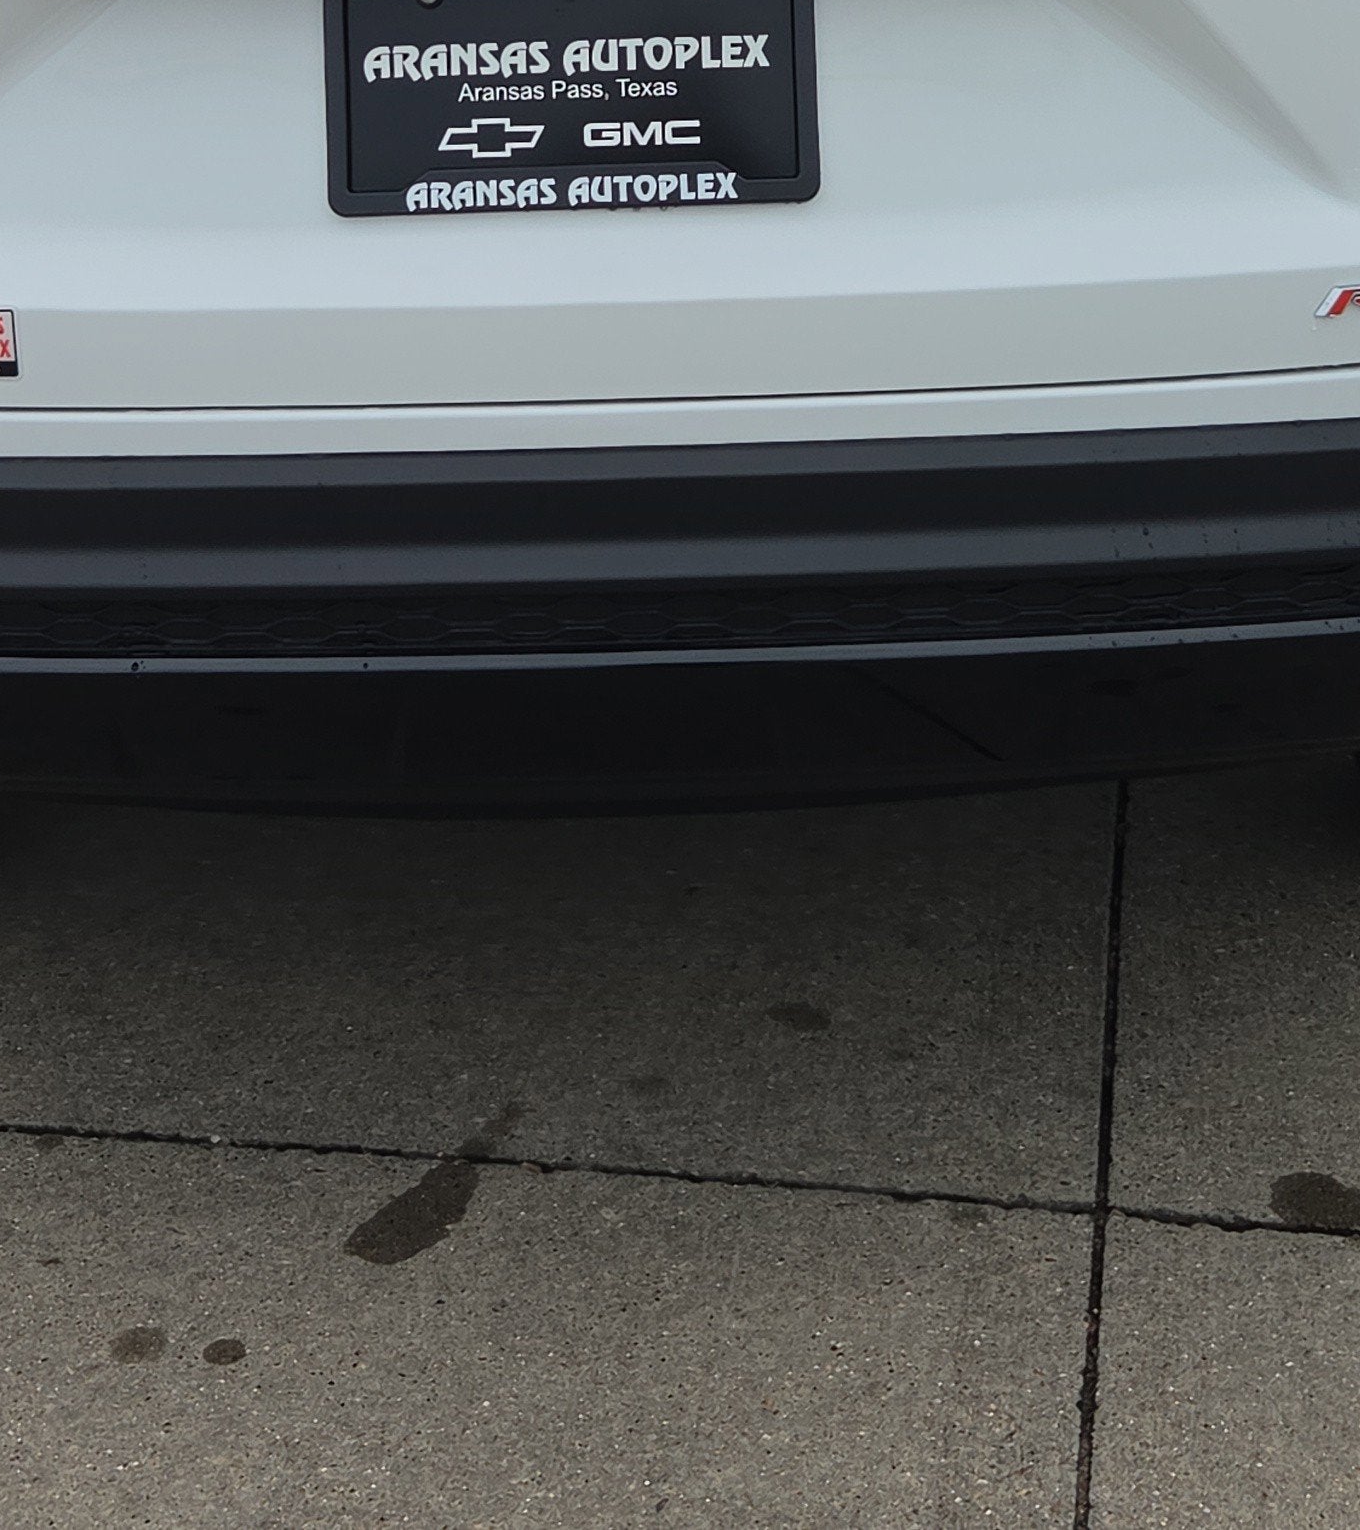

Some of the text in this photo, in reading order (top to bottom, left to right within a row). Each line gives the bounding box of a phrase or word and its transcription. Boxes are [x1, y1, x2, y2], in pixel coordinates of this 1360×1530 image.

[362, 33, 771, 84] ARANSAS AUTOPLEX
[457, 77, 678, 103] Aransas Pass, Texas
[583, 119, 701, 148] GMC
[405, 172, 740, 213] ARANSAS AUTOPLEX
